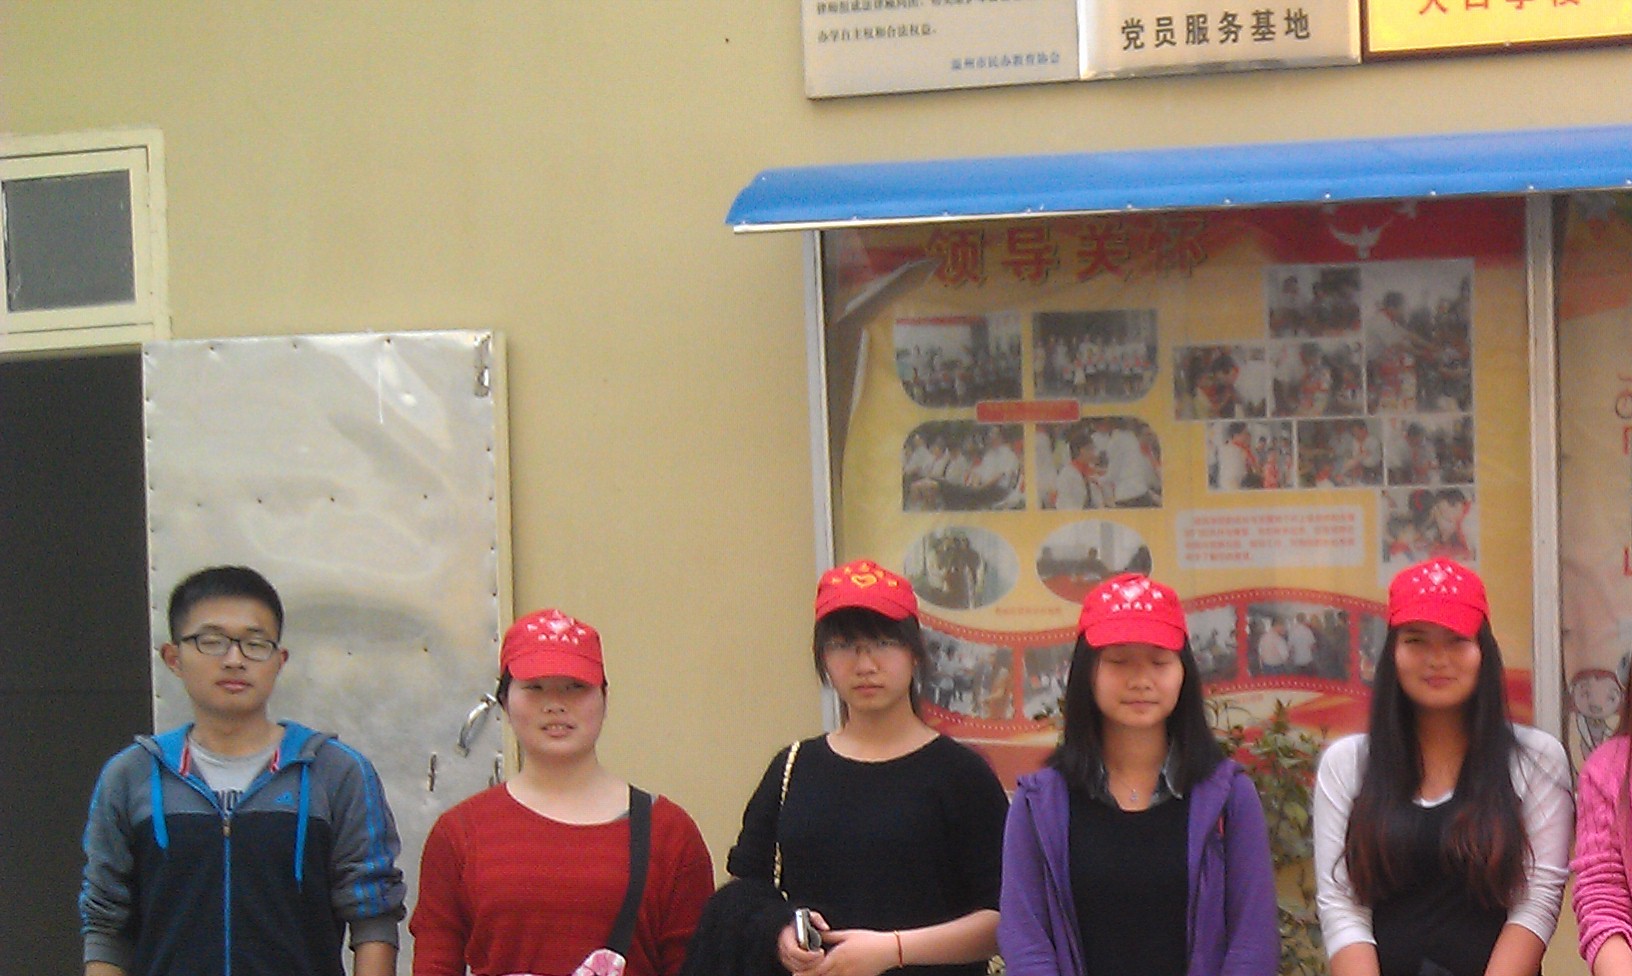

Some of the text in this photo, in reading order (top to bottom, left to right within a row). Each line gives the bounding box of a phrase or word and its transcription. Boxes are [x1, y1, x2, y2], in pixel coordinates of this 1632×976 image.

[1120, 9, 1312, 51] 党员服务基地
